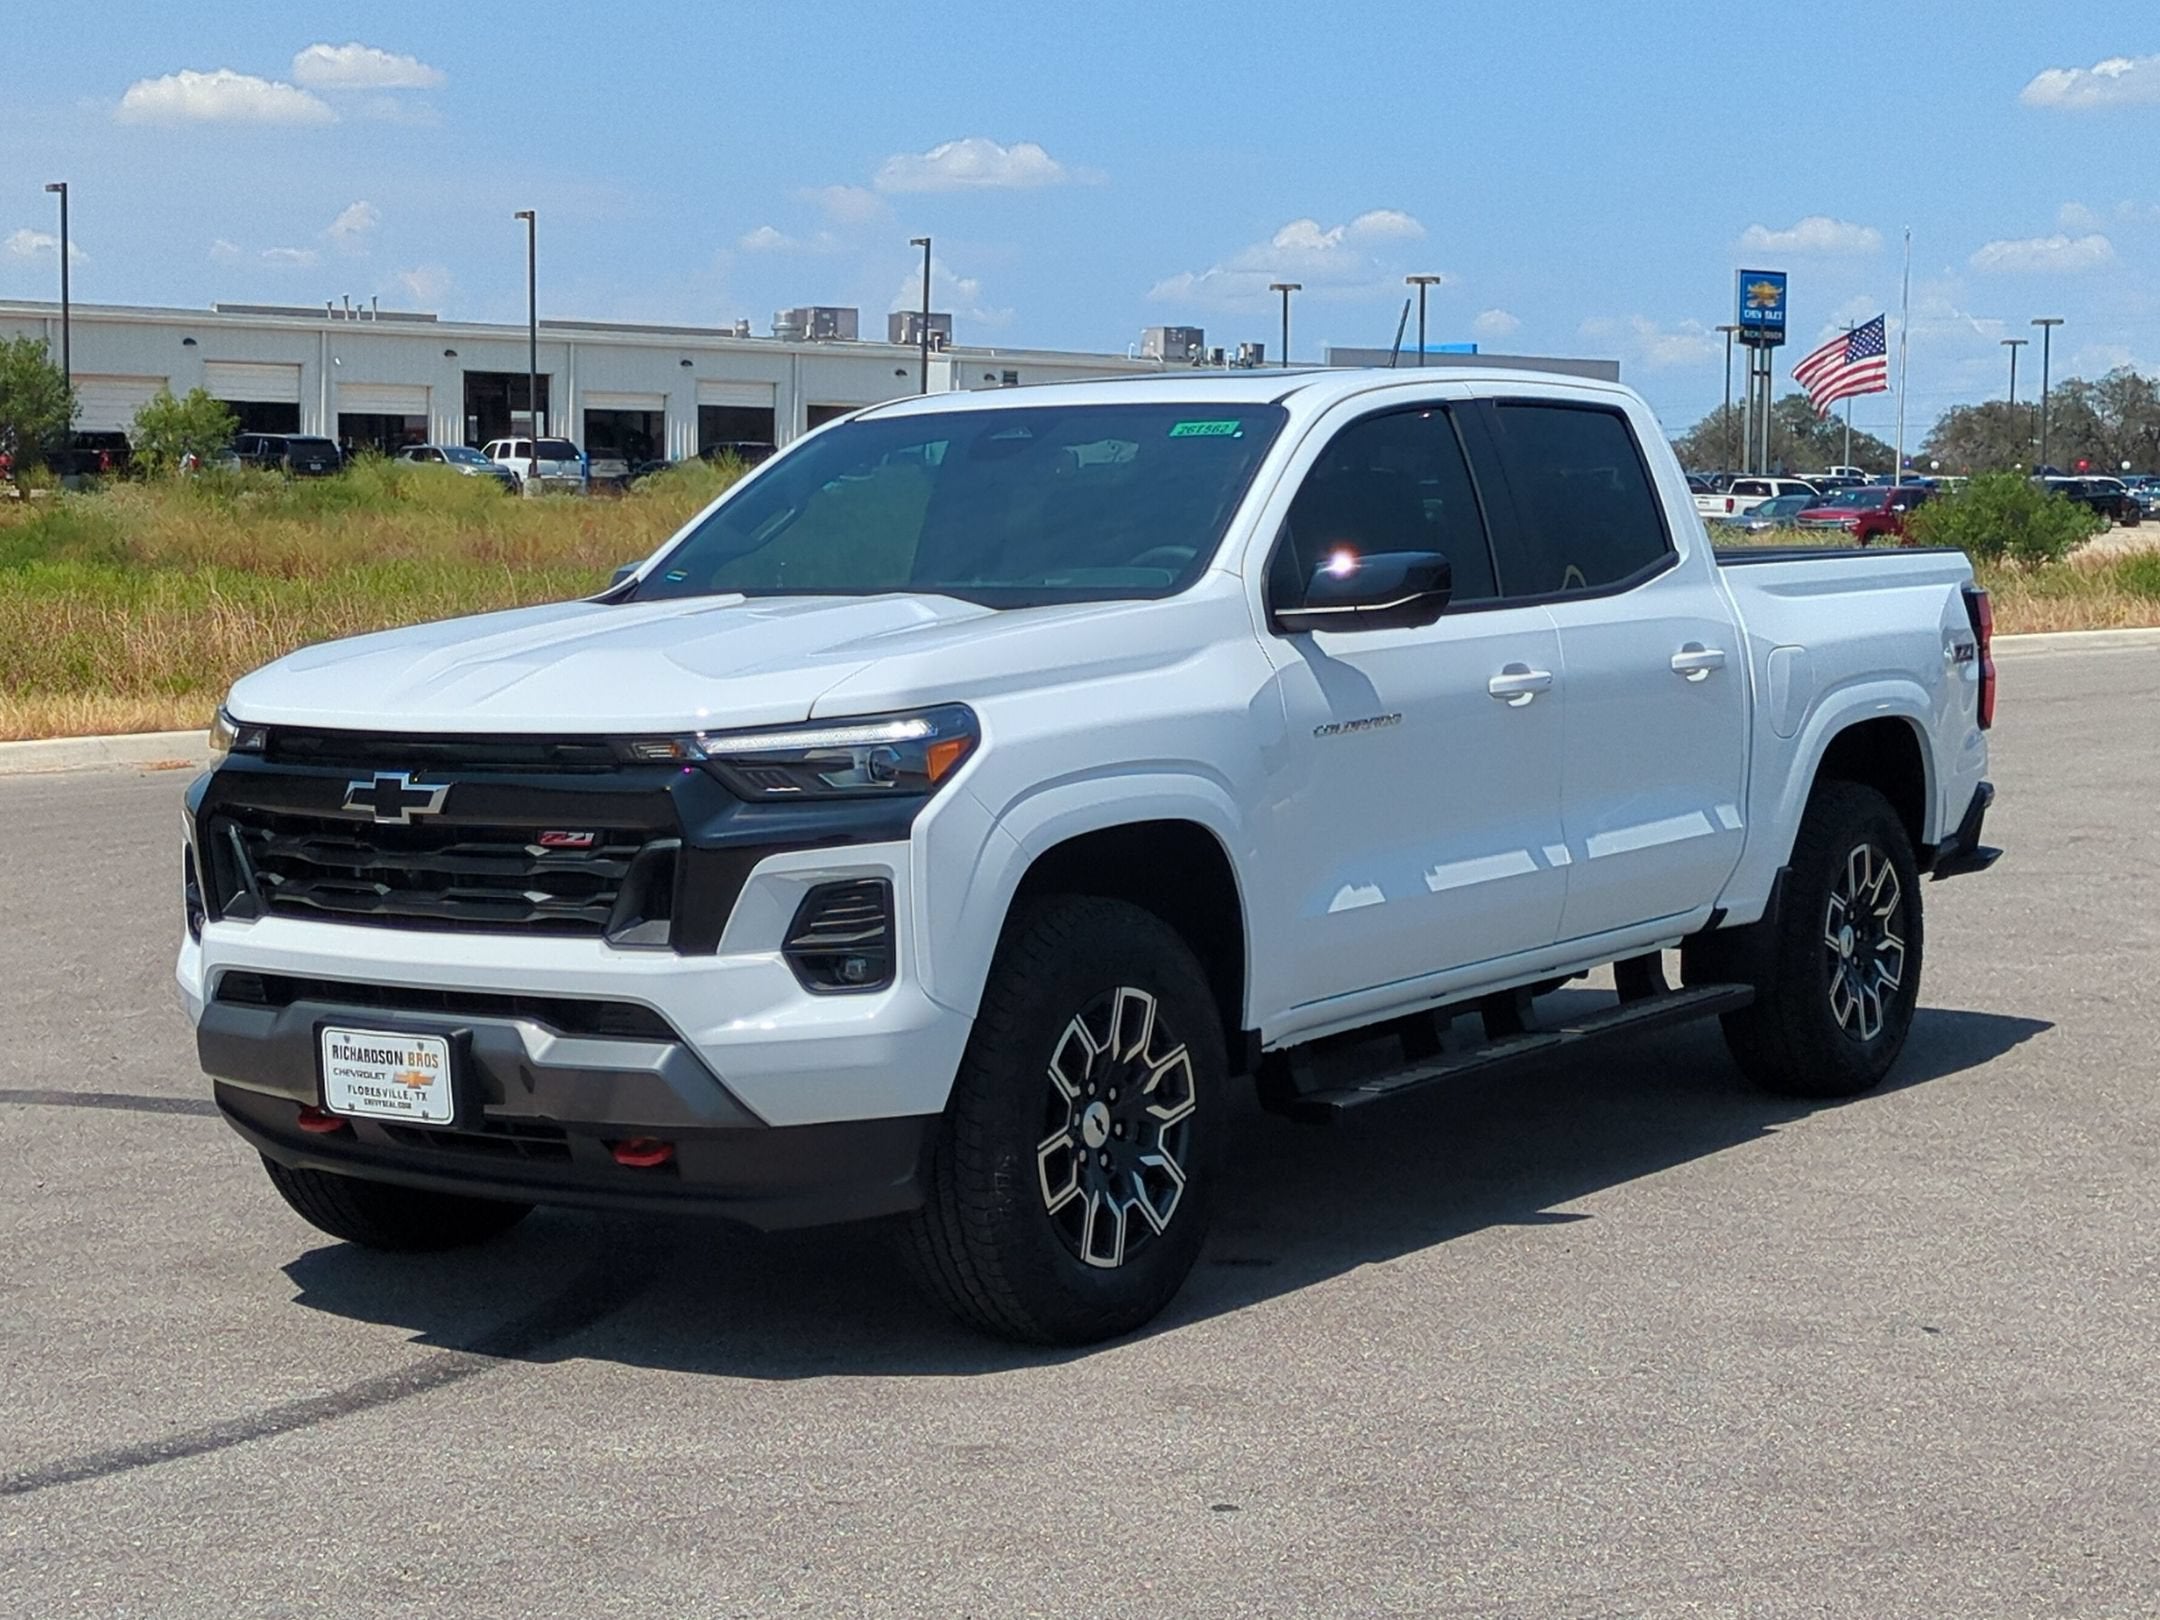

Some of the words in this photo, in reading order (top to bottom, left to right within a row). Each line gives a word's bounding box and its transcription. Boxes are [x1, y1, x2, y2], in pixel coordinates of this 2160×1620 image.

[332, 1045, 404, 1066] RICHARDSON
[407, 1051, 439, 1069] BROS
[333, 1067, 387, 1081] CHEVROLET
[415, 1091, 428, 1102] TX
